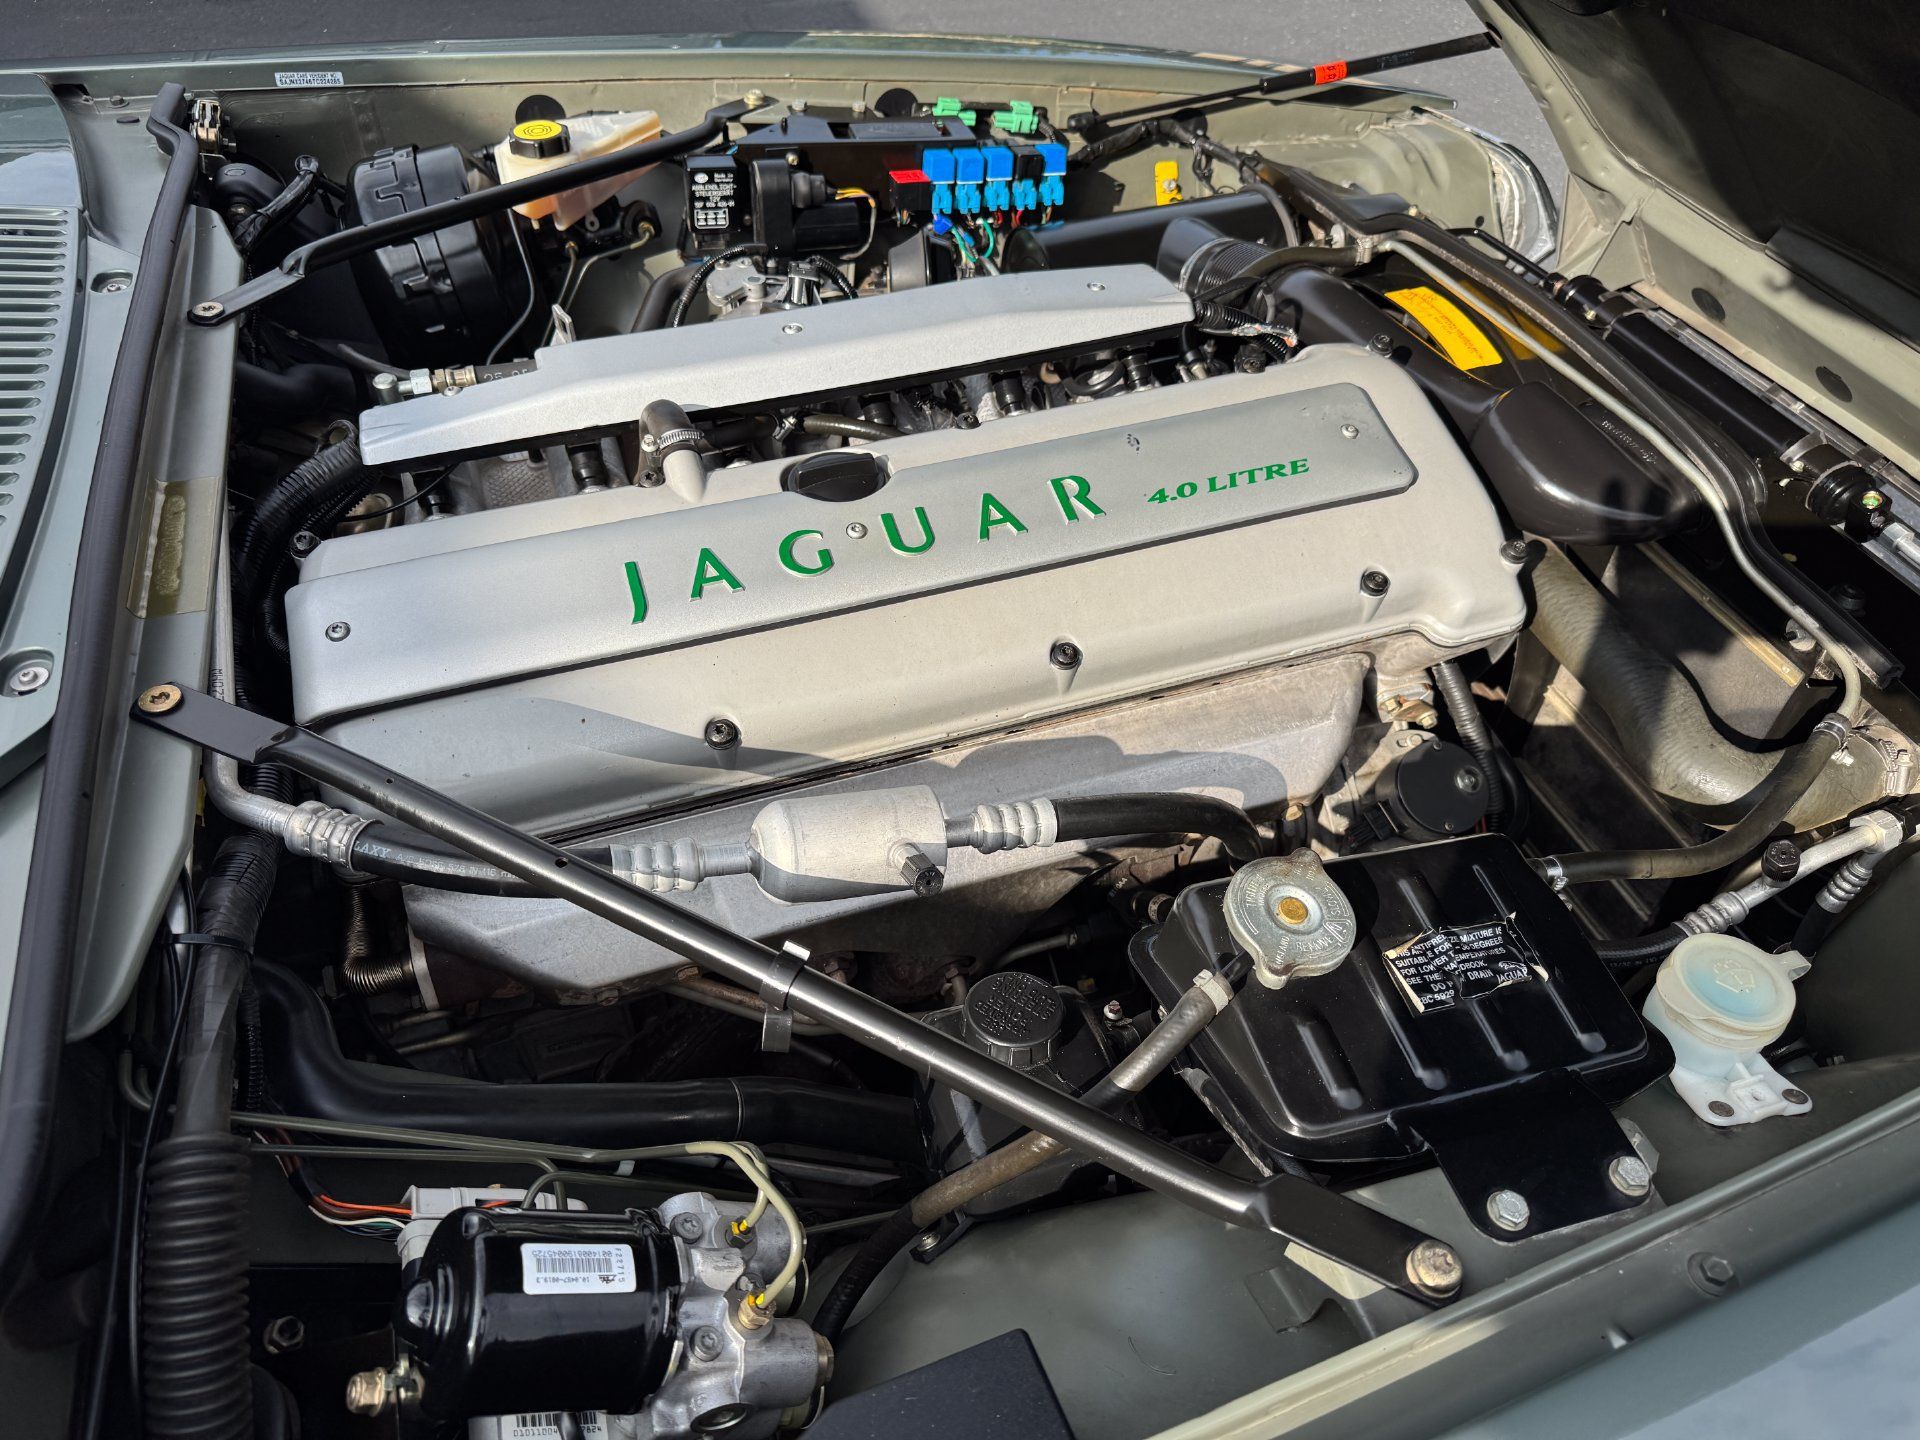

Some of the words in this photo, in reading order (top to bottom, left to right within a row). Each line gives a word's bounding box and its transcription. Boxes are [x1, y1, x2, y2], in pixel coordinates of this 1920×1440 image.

[1147, 481, 1199, 505] 4.0
[1207, 457, 1310, 494] LITRE
[623, 474, 1105, 624] JAGUAR
[1459, 928, 1494, 943] MIXTURE
[1395, 949, 1434, 968] SUITABLE
[1434, 941, 1453, 958] FOR
[1469, 936, 1504, 950] DEGREES
[1401, 967, 1418, 977] FOR
[1406, 975, 1424, 986] SEE
[1425, 971, 1442, 982] THE
[1430, 982, 1447, 993] DO
[1466, 968, 1495, 982] DRAIN
